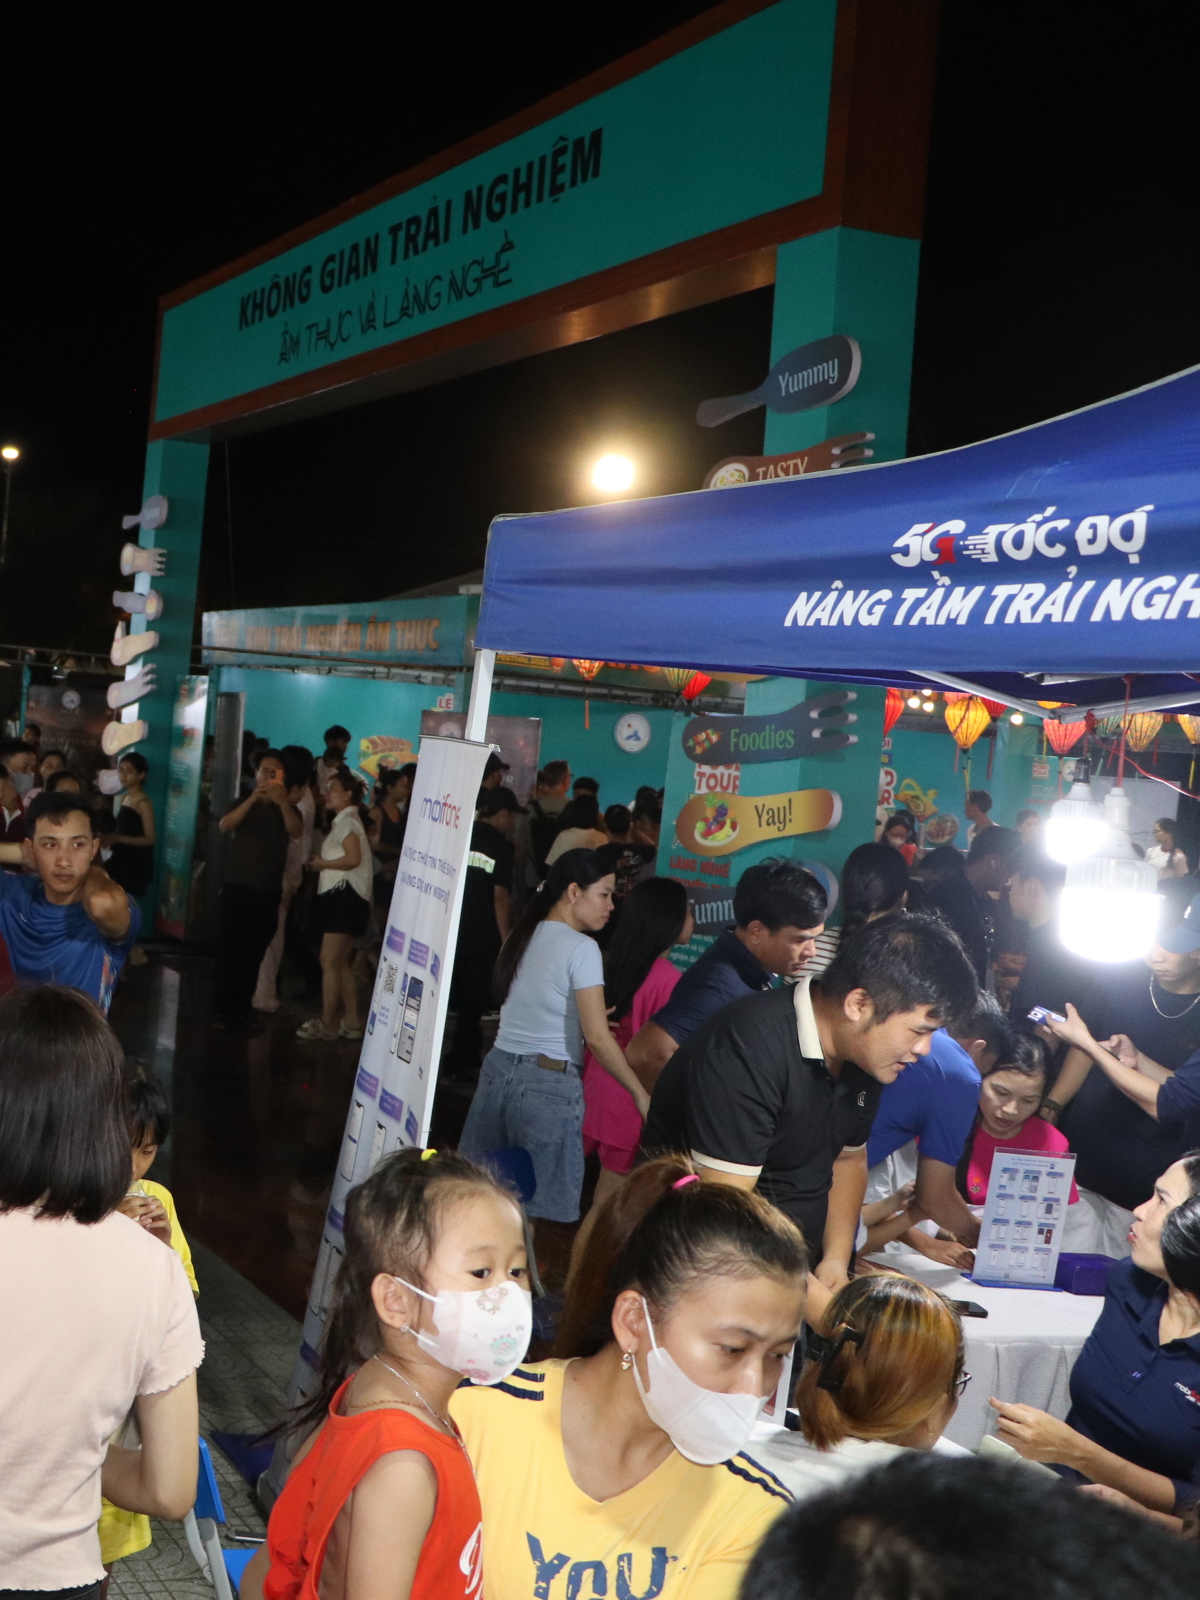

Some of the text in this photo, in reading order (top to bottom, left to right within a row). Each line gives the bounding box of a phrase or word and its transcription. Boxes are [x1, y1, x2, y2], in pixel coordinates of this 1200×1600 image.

[238, 127, 603, 332] KHÔNG GIAN TRẢI NGHIỆM
[383, 275, 443, 328] LÀNG
[778, 358, 839, 396] Yummy
[756, 456, 809, 480] TASTY
[888, 520, 966, 568] 5G
[784, 566, 1200, 627] NÂNG TẦM TRẢI NGH
[729, 724, 795, 753] Foodies
[754, 797, 793, 832] Yay!
[688, 898, 736, 925] umm
[526, 1531, 667, 1600] YOU
